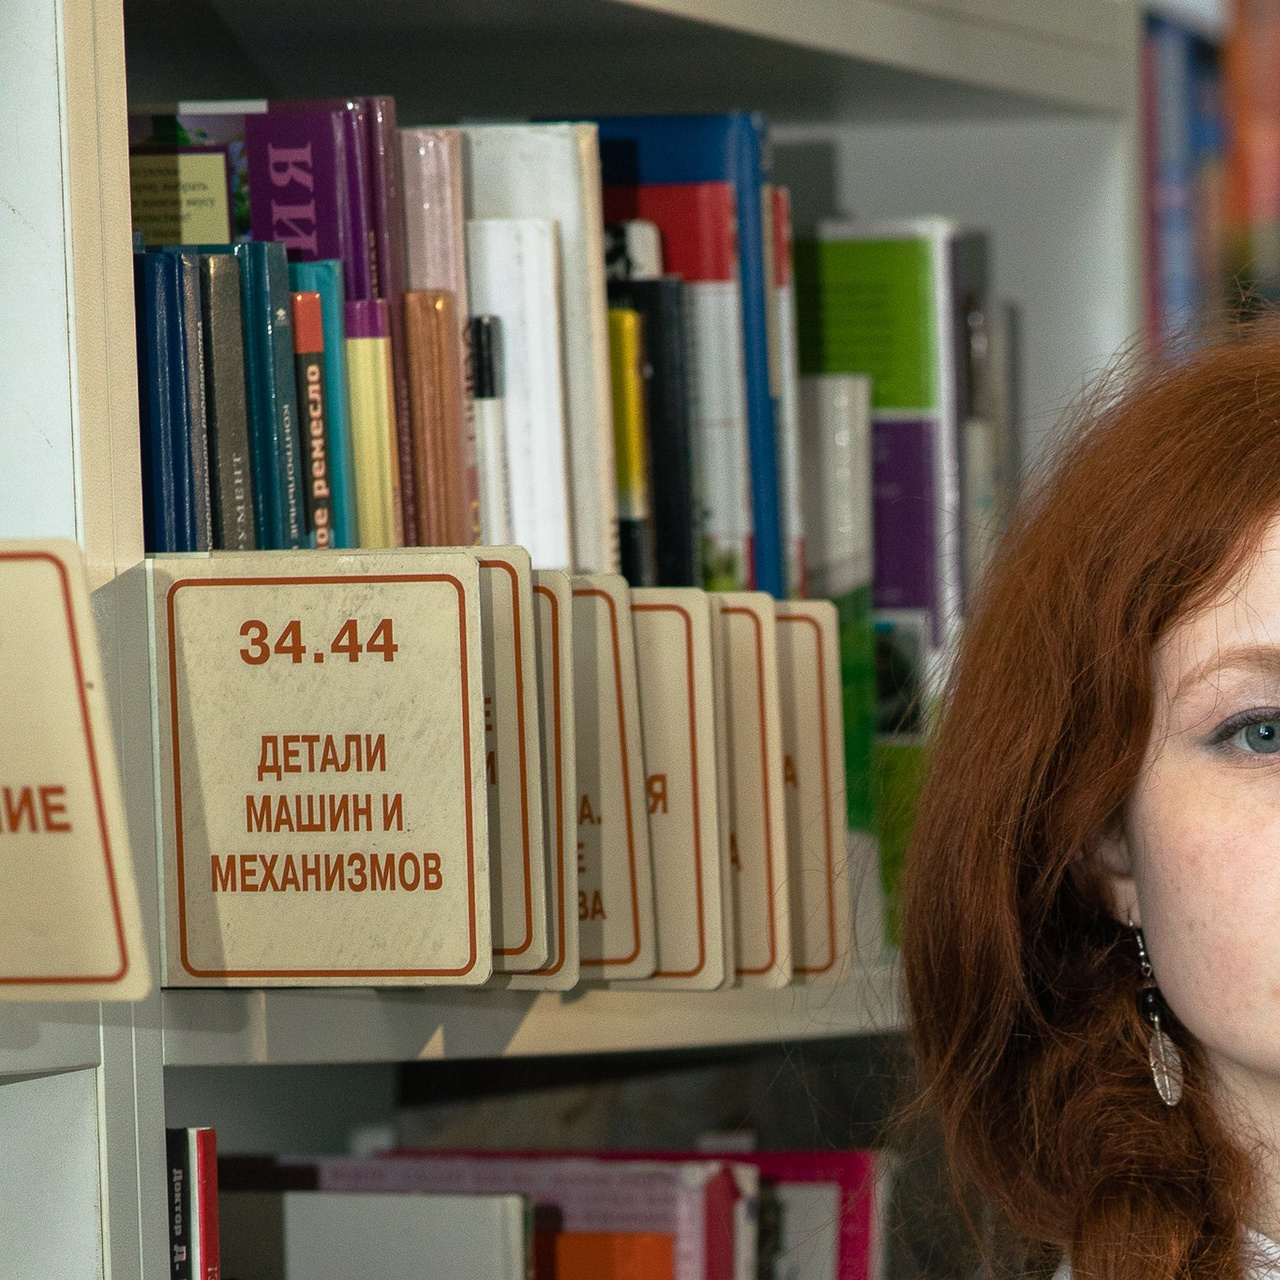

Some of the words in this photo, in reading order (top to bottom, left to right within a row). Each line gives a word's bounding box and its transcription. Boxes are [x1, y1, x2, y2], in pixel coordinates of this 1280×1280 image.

[306, 365, 331, 499] ремесло
[239, 618, 400, 665] 34.44
[257, 734, 387, 782] ДЕТАЛИ
[0, 785, 72, 833] ИЕ
[245, 794, 373, 833] МАШИН
[381, 793, 404, 832] И
[211, 851, 443, 892] МЕХАНИЗМОВ
[173, 1167, 184, 1236] Доктор
[174, 1244, 187, 1271] Д.
